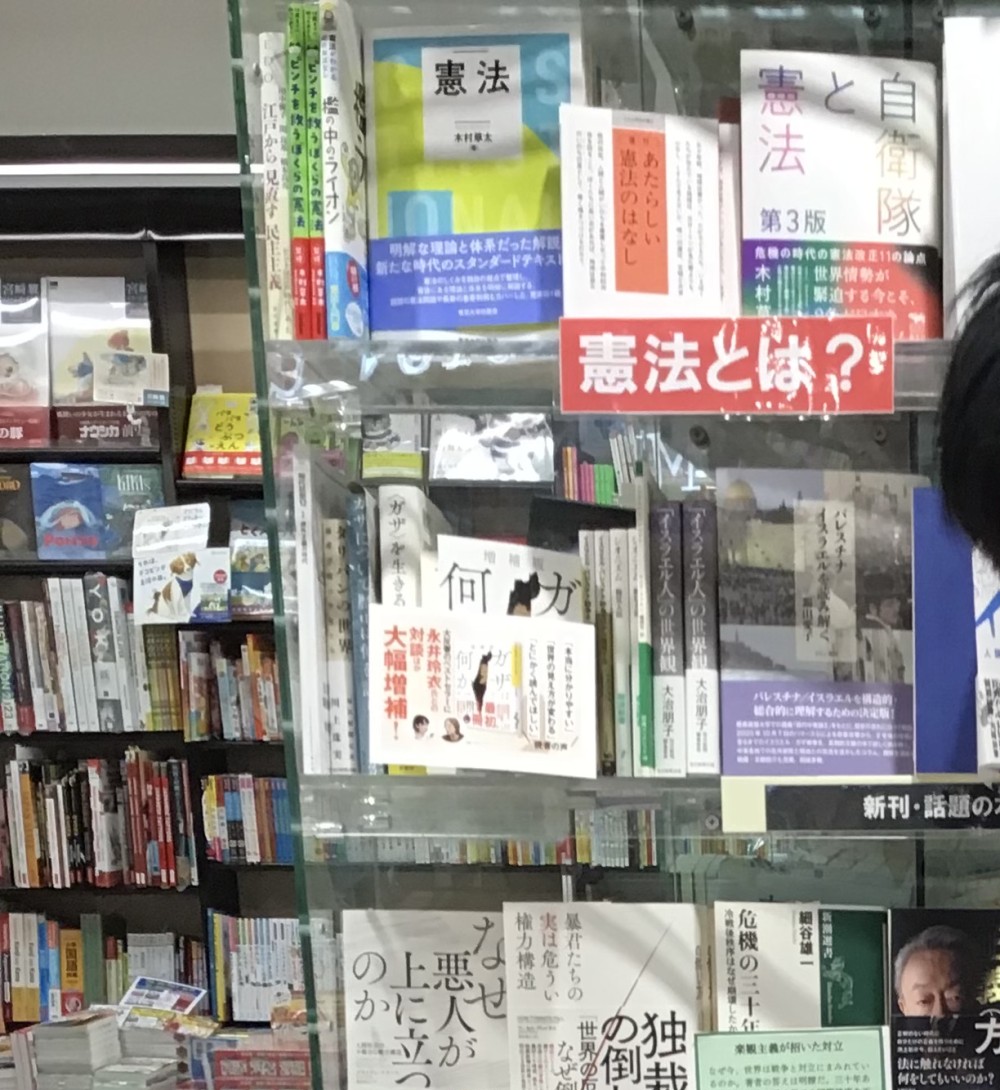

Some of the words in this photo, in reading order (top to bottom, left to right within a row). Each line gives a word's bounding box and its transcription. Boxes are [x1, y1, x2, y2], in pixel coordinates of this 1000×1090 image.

[434, 58, 510, 96] 憲法
[824, 72, 856, 115] と
[757, 65, 806, 175] 憲法
[875, 72, 922, 236] 自衛隊
[620, 149, 640, 266] 憲法のはなし
[643, 151, 661, 246] あたらしい
[760, 208, 826, 234] 第3版
[440, 562, 490, 613] 何
[536, 572, 581, 616] ガ
[515, 912, 536, 991] 権力構造
[540, 913, 560, 1002] 実は危うい
[565, 913, 583, 1001] 暴君たちの
[799, 910, 814, 967] 細谷雄一
[353, 952, 390, 1022] のか
[389, 951, 433, 1089] 上に立つ
[433, 950, 477, 1067] 悪人が
[735, 1041, 844, 1054] 楽観主義が招いた対立
